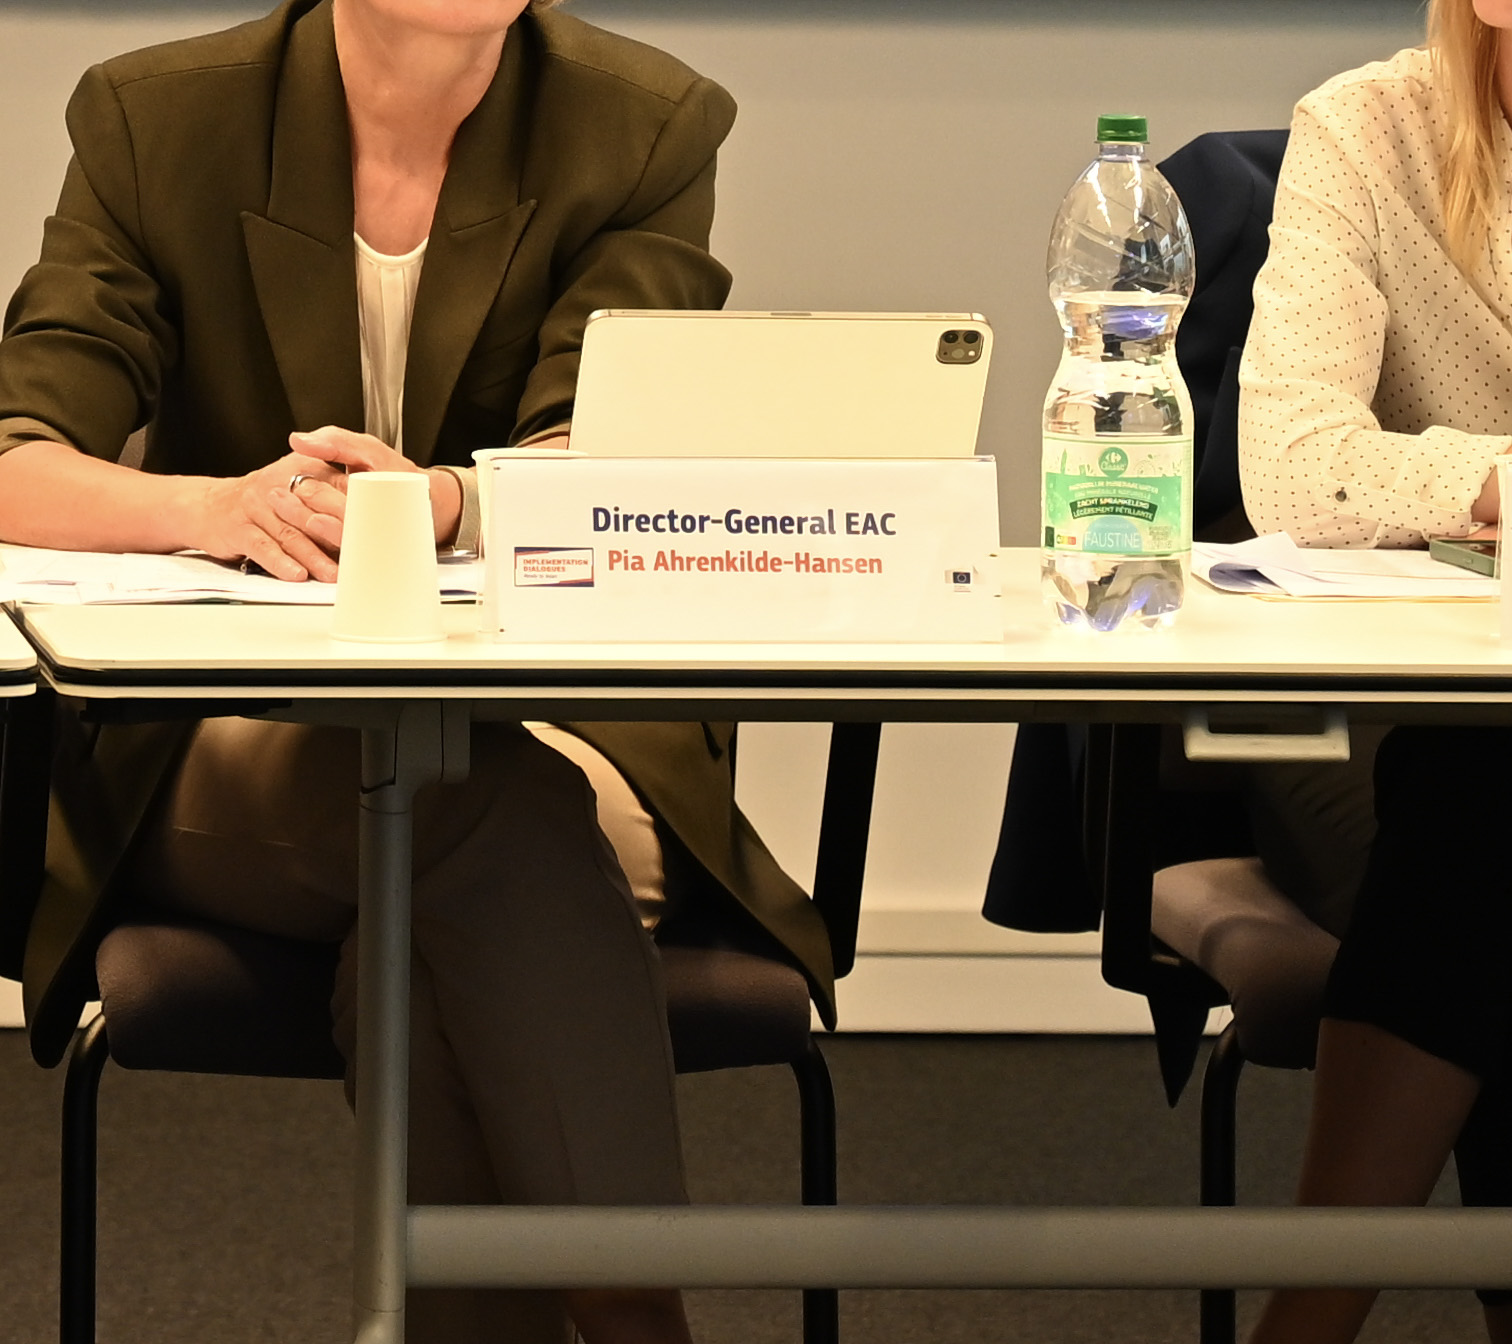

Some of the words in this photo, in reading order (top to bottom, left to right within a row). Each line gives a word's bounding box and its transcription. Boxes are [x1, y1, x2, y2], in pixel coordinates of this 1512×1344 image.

[592, 506, 836, 535] Director-General
[845, 512, 897, 536] EAC
[1084, 532, 1141, 548] FAUSTINE
[607, 549, 645, 571] Pia
[653, 549, 883, 574] Ahrenkilde-Hansen
